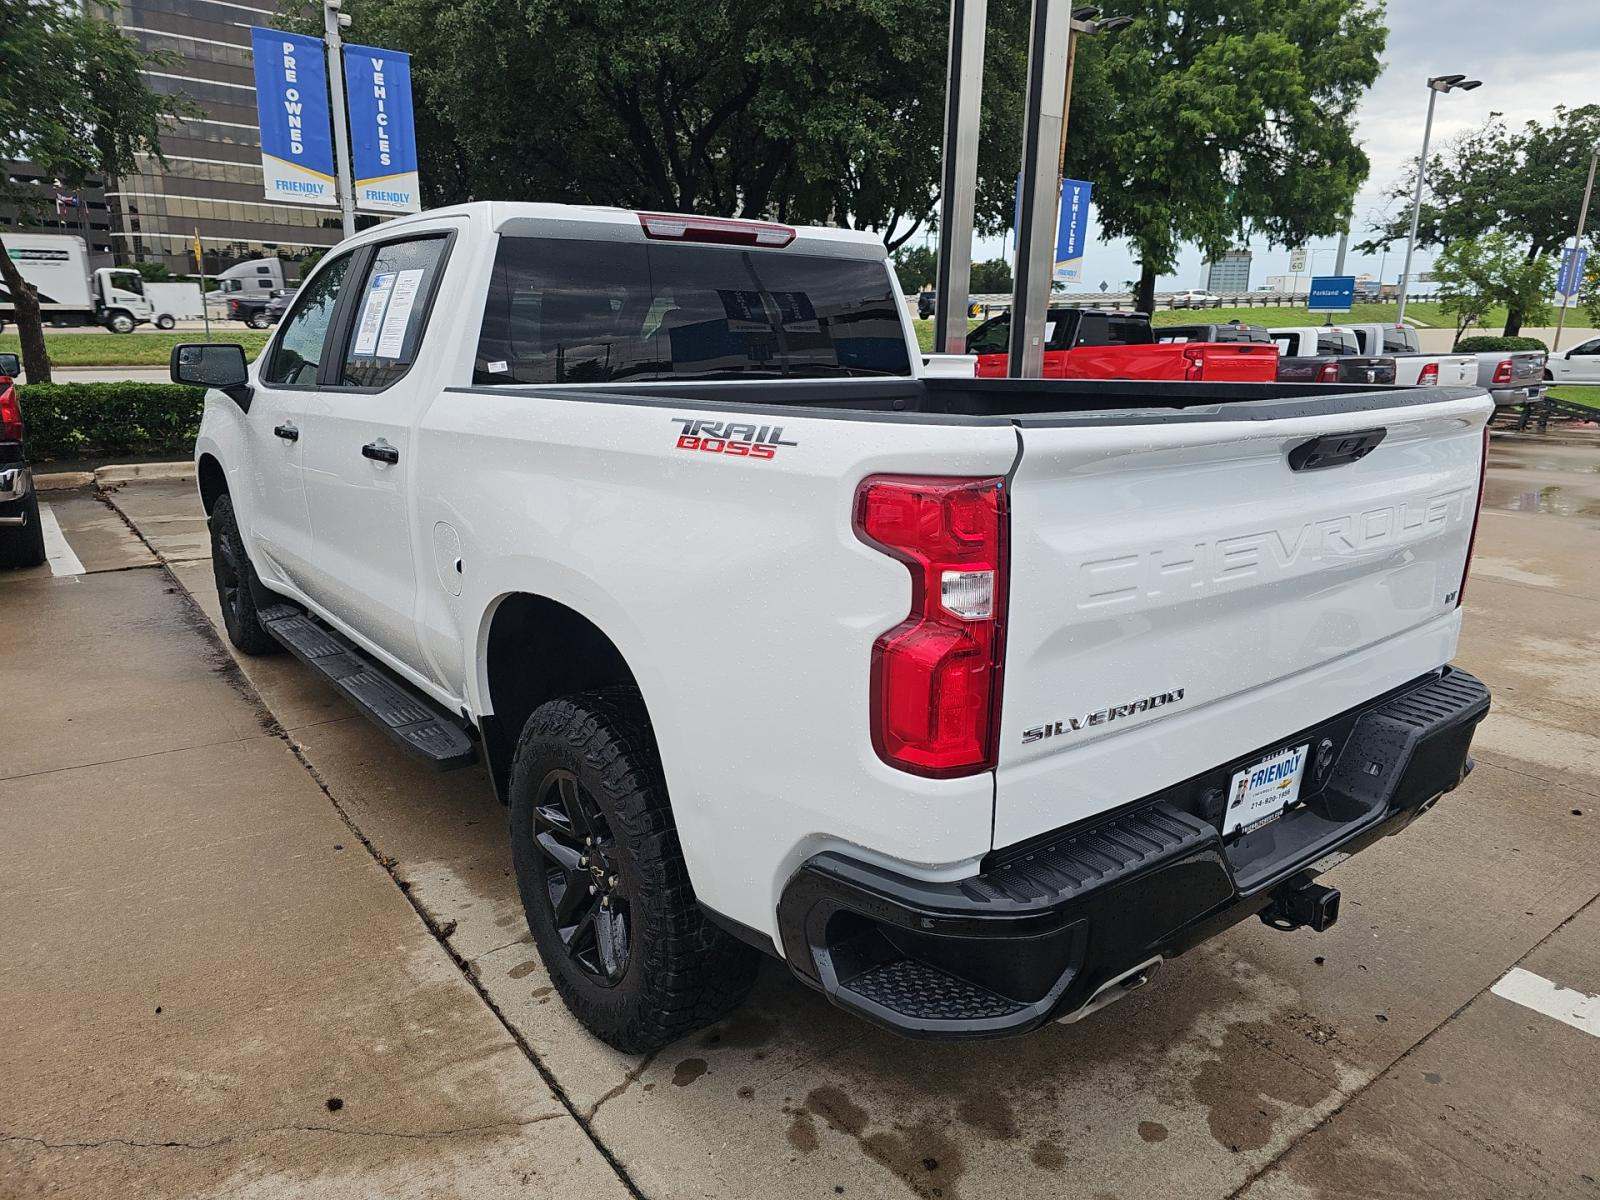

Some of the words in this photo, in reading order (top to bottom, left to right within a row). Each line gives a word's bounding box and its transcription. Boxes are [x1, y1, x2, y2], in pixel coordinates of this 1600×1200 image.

[283, 42, 297, 83] PRE
[285, 88, 304, 155] OWNED
[371, 57, 391, 166] VEHICLES
[275, 179, 324, 194] FRIENDLY
[366, 190, 410, 203] FRIENDLY
[1068, 186, 1081, 254] VEHICLES
[1292, 262, 1303, 270] 60
[671, 417, 798, 447] TRAIL
[676, 435, 778, 459] BOSS
[1077, 485, 1472, 609] CHEVROLET
[1022, 688, 1185, 744] SILVERADO
[1249, 754, 1302, 790] FRIENDLY
